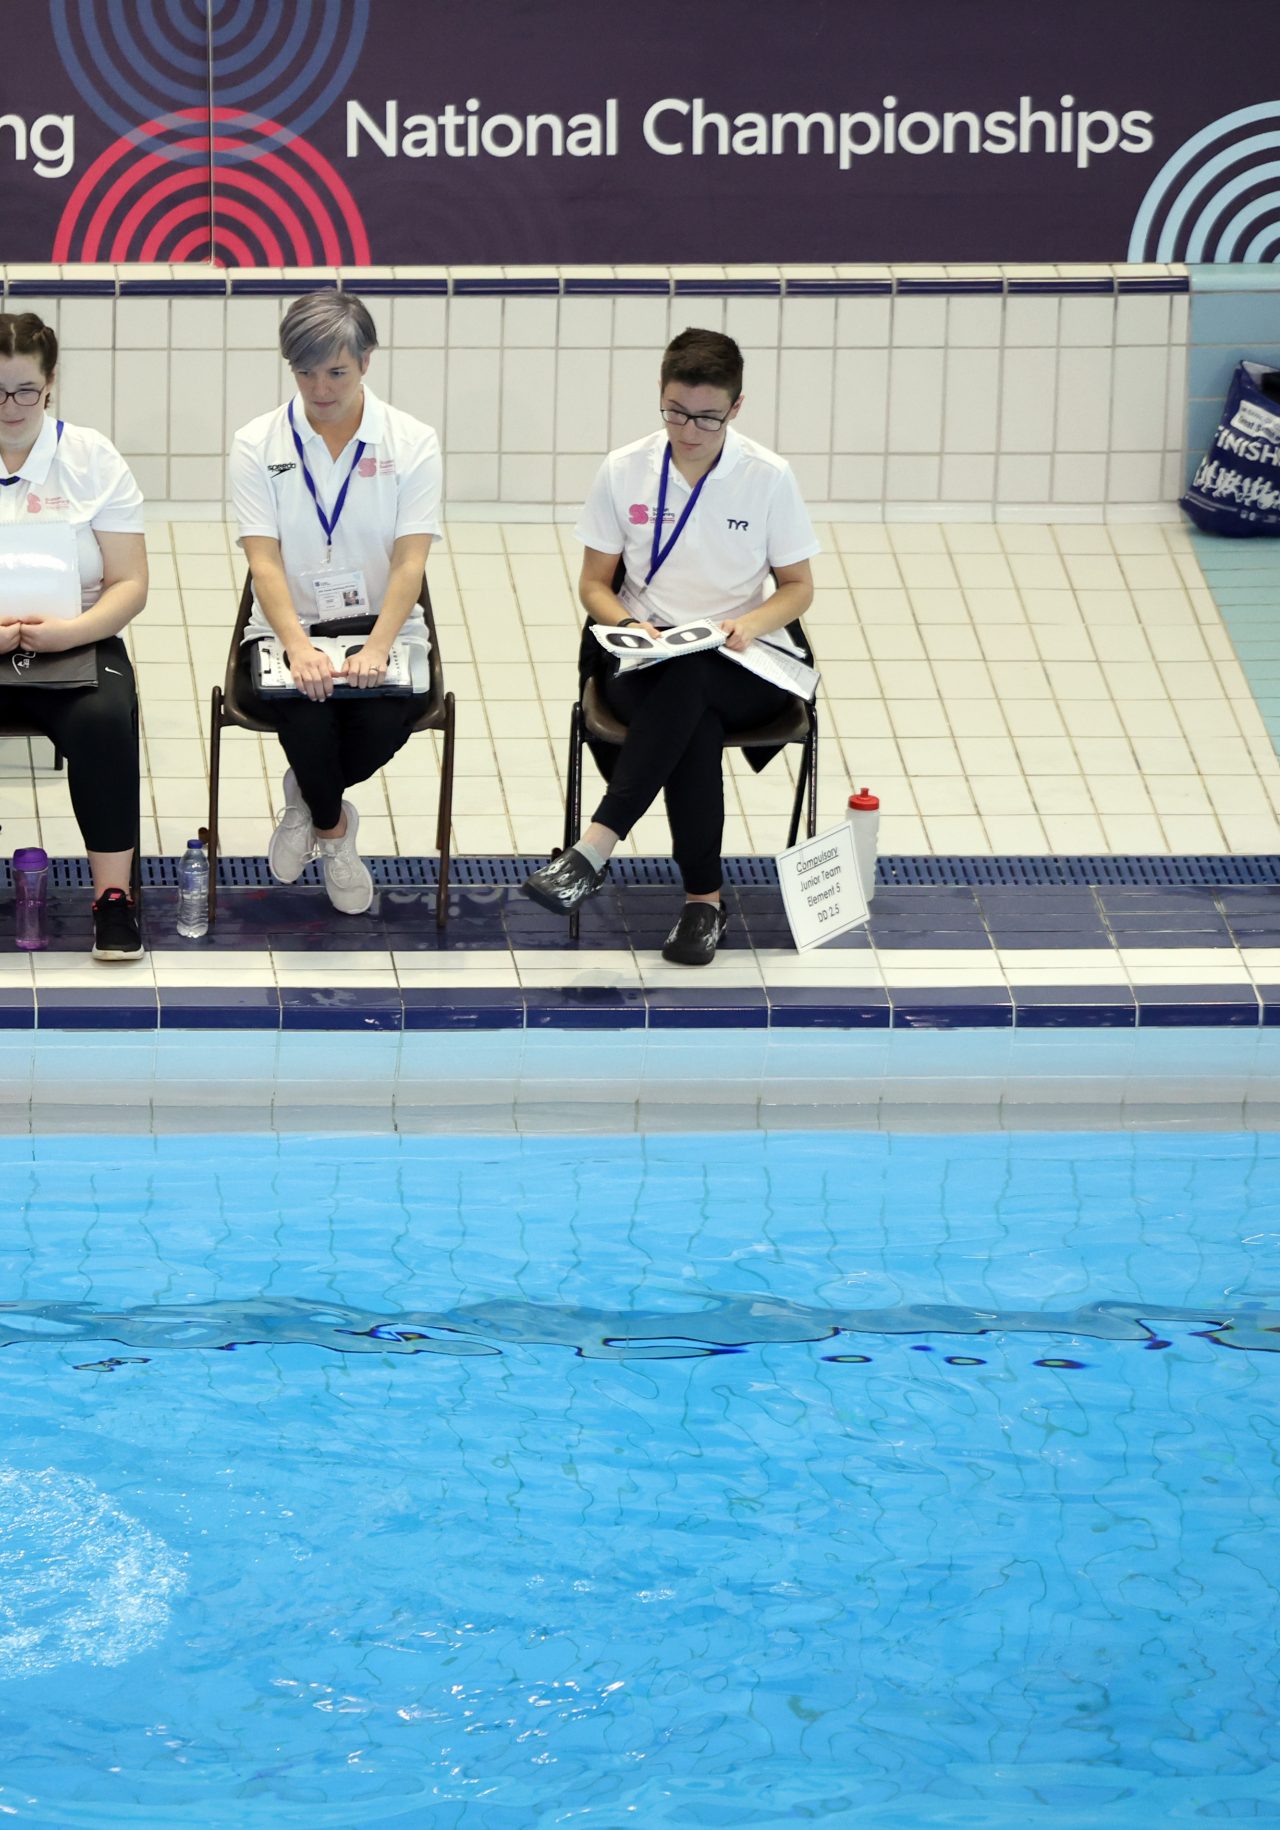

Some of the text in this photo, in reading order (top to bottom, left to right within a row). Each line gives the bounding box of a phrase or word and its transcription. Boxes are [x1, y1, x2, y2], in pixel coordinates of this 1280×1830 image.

[346, 95, 1154, 169] National Championships
[726, 518, 749, 531] TYR
[796, 847, 838, 873] Compulsory
[800, 865, 841, 892] Junior Team
[807, 882, 841, 907] Element 5
[817, 904, 840, 923] DD 2.5
